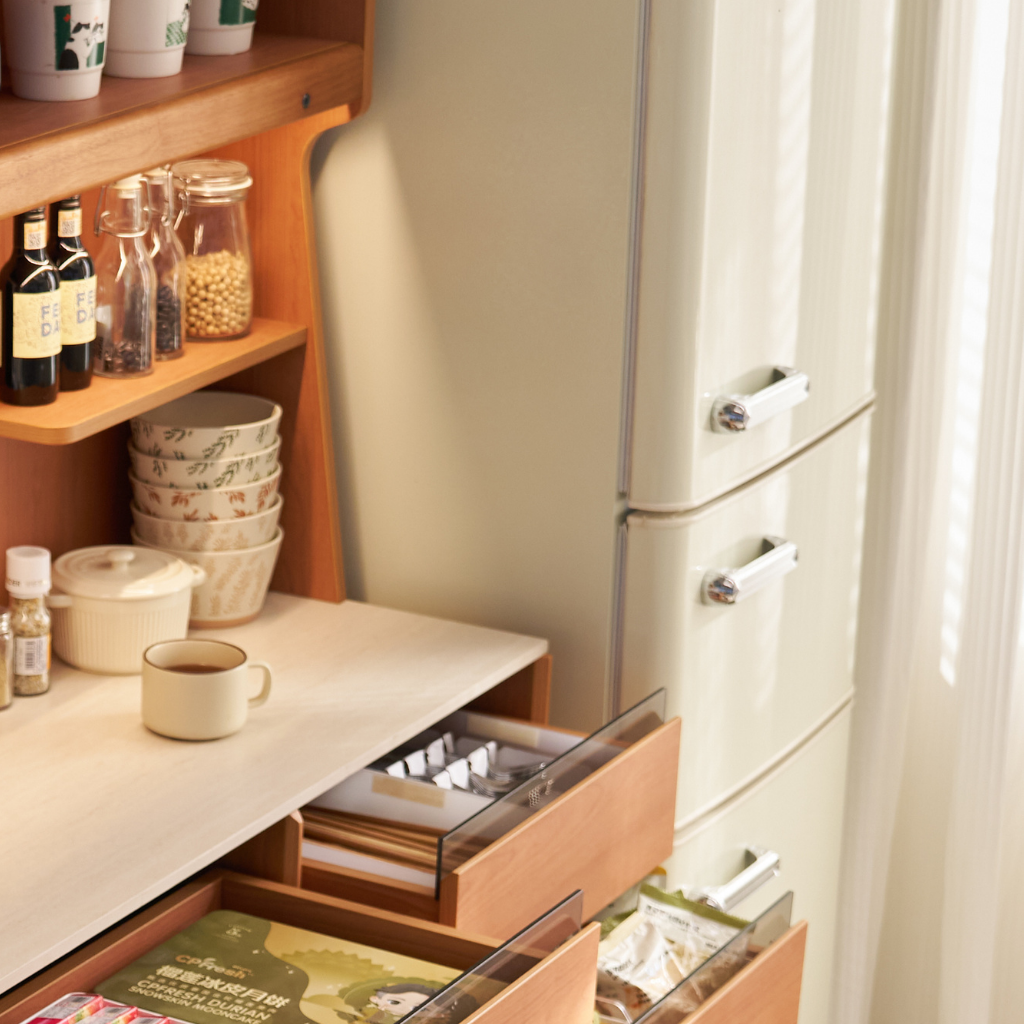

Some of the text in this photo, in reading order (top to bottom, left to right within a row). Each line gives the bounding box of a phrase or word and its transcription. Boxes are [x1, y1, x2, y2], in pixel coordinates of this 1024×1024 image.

[128, 985, 193, 1008] SNOWSKIN
[137, 980, 207, 1003] CPFRESH
[207, 998, 271, 1021] DURIAN
